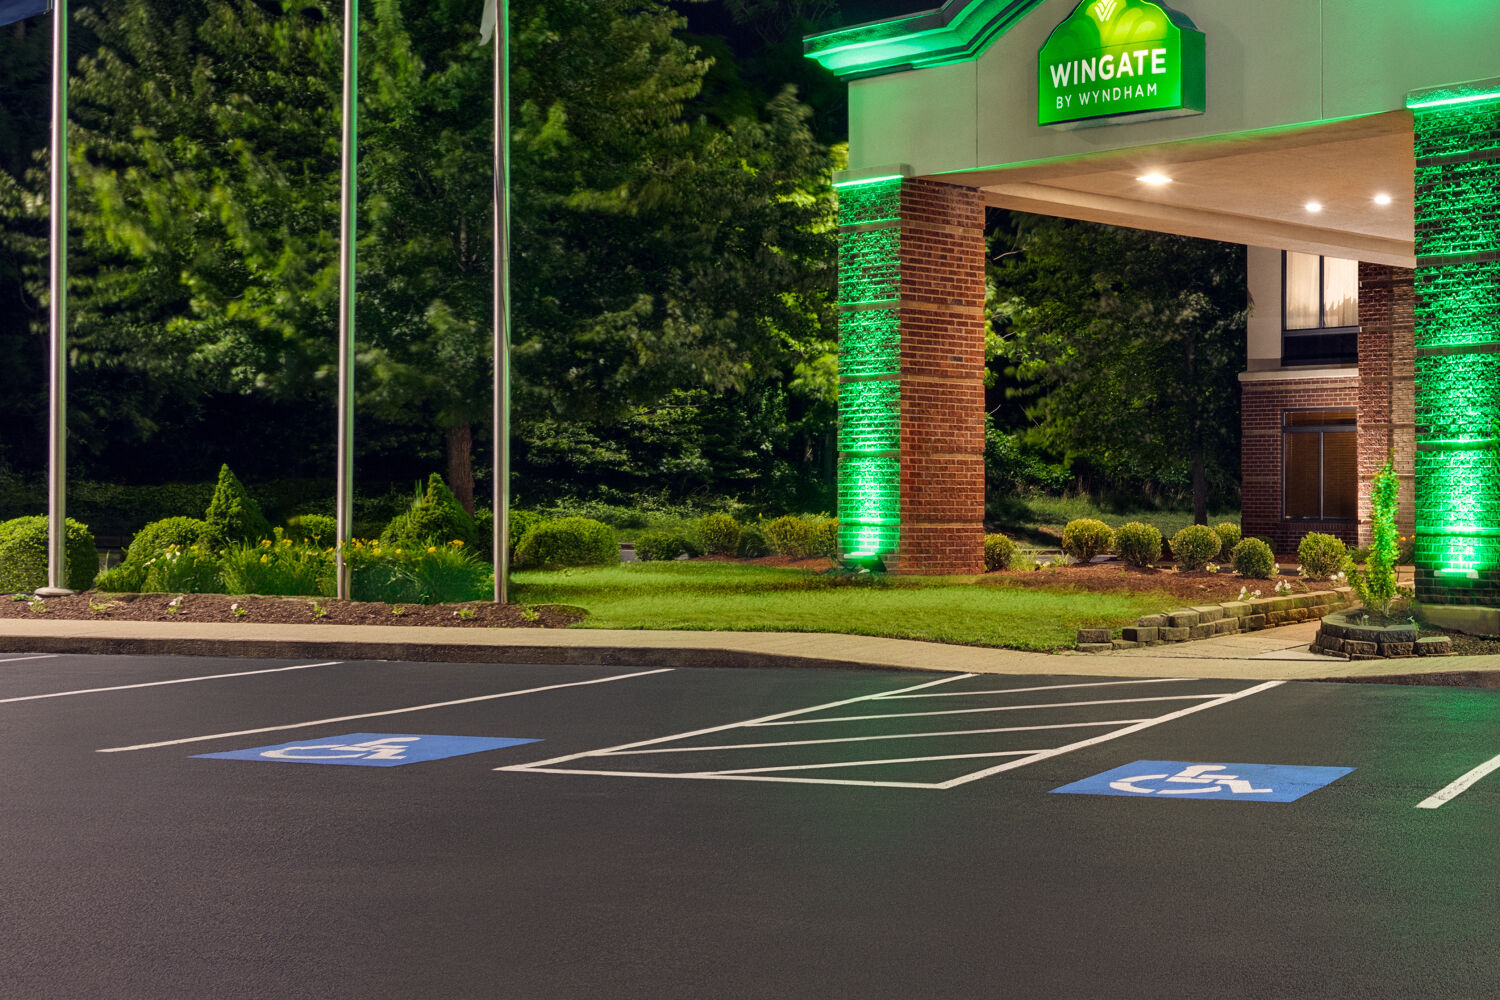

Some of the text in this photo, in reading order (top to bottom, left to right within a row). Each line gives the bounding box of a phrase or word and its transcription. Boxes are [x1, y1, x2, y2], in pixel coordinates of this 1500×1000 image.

[1050, 48, 1167, 88] WINGATE
[1056, 83, 1157, 109] BY WYNDHAM
